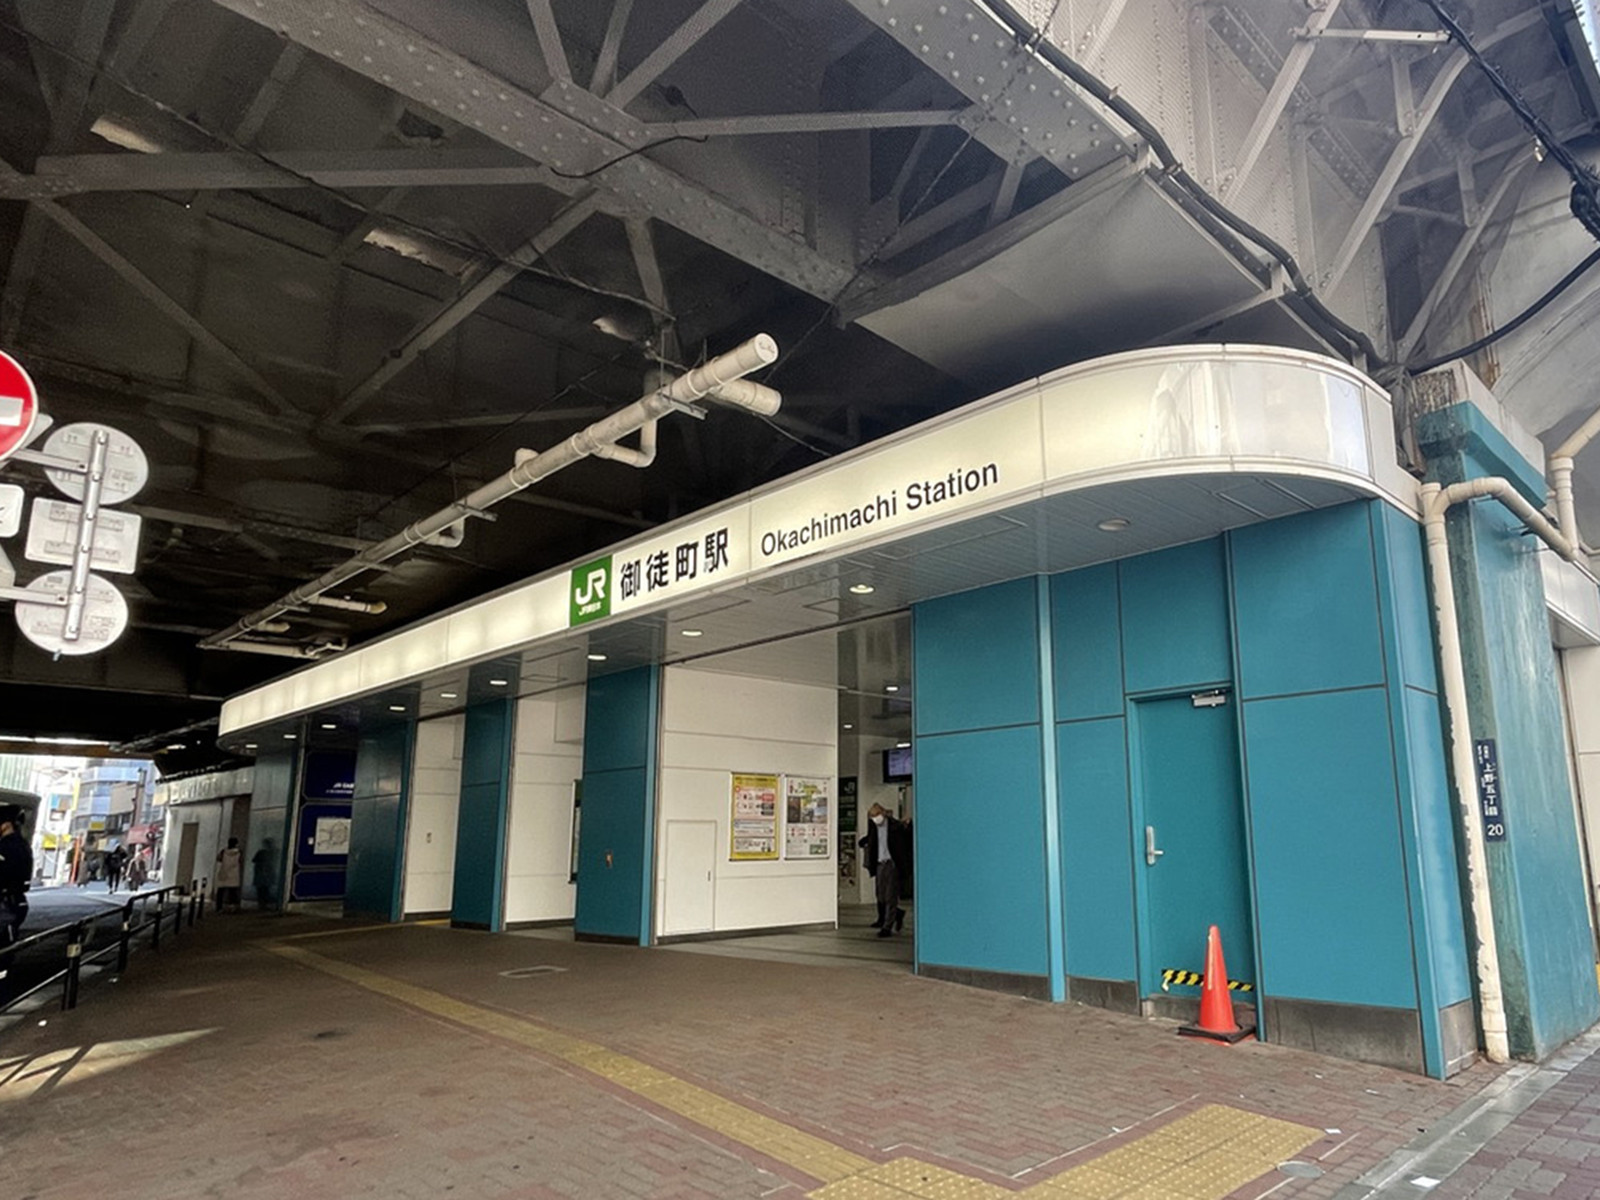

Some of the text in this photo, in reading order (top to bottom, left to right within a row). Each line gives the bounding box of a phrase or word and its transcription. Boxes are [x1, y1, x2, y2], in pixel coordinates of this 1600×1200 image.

[761, 462, 998, 556] Okachimachi Station
[575, 568, 606, 605] JR
[620, 527, 729, 600] 御徒町駅
[1487, 823, 1504, 836] 20
